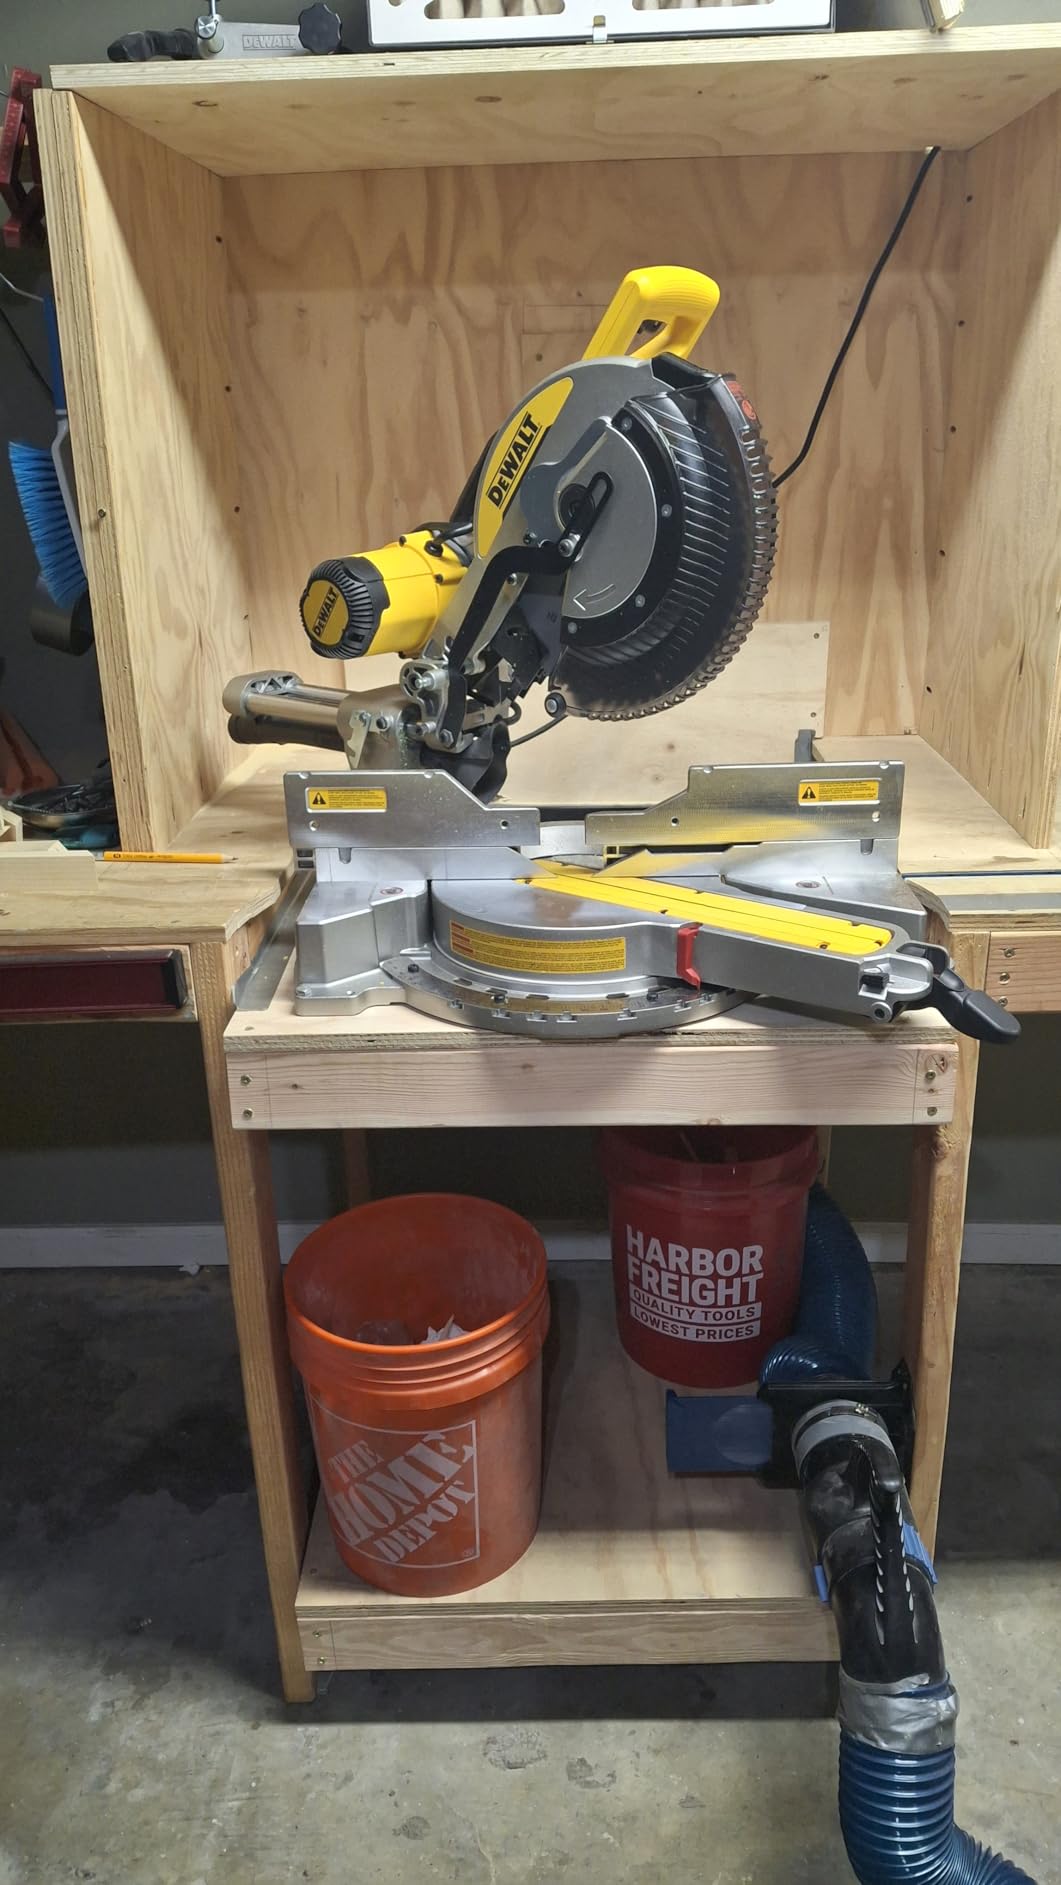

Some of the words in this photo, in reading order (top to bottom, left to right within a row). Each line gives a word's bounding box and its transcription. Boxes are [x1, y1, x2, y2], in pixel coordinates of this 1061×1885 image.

[487, 412, 539, 508] DEWALT
[312, 586, 338, 637] DEWALT
[626, 1223, 764, 1277] HARBOR
[627, 1253, 764, 1306] FREIGHT
[633, 1288, 696, 1320] QUALITY
[702, 1306, 756, 1322] TOOLS
[633, 1306, 690, 1338] LOWEST
[695, 1325, 755, 1340] PRICES
[328, 1439, 384, 1484] THE
[330, 1431, 475, 1547] HOME
[373, 1479, 475, 1563] DEPOT
